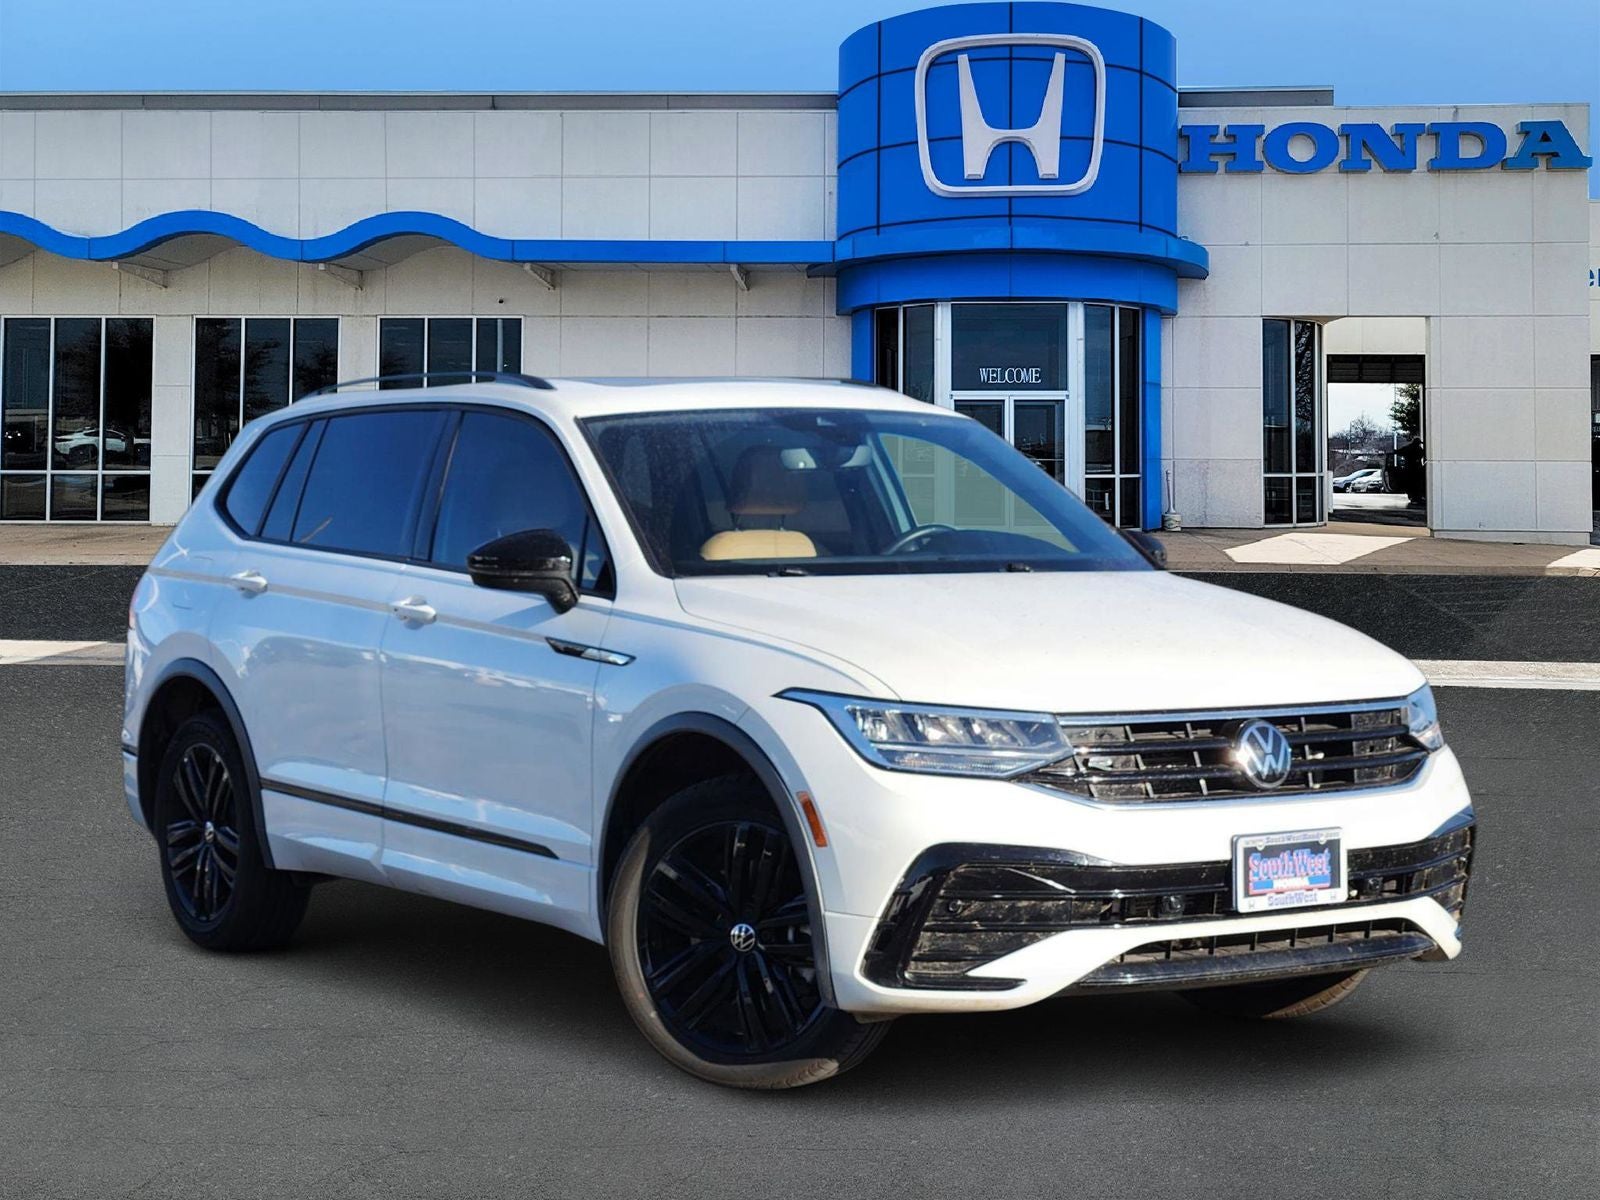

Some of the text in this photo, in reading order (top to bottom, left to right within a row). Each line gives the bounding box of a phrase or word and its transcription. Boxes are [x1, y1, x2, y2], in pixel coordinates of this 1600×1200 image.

[1179, 120, 1593, 174] HONDA
[979, 367, 1041, 384] WELCOME
[1268, 892, 1318, 907] SouthWest
